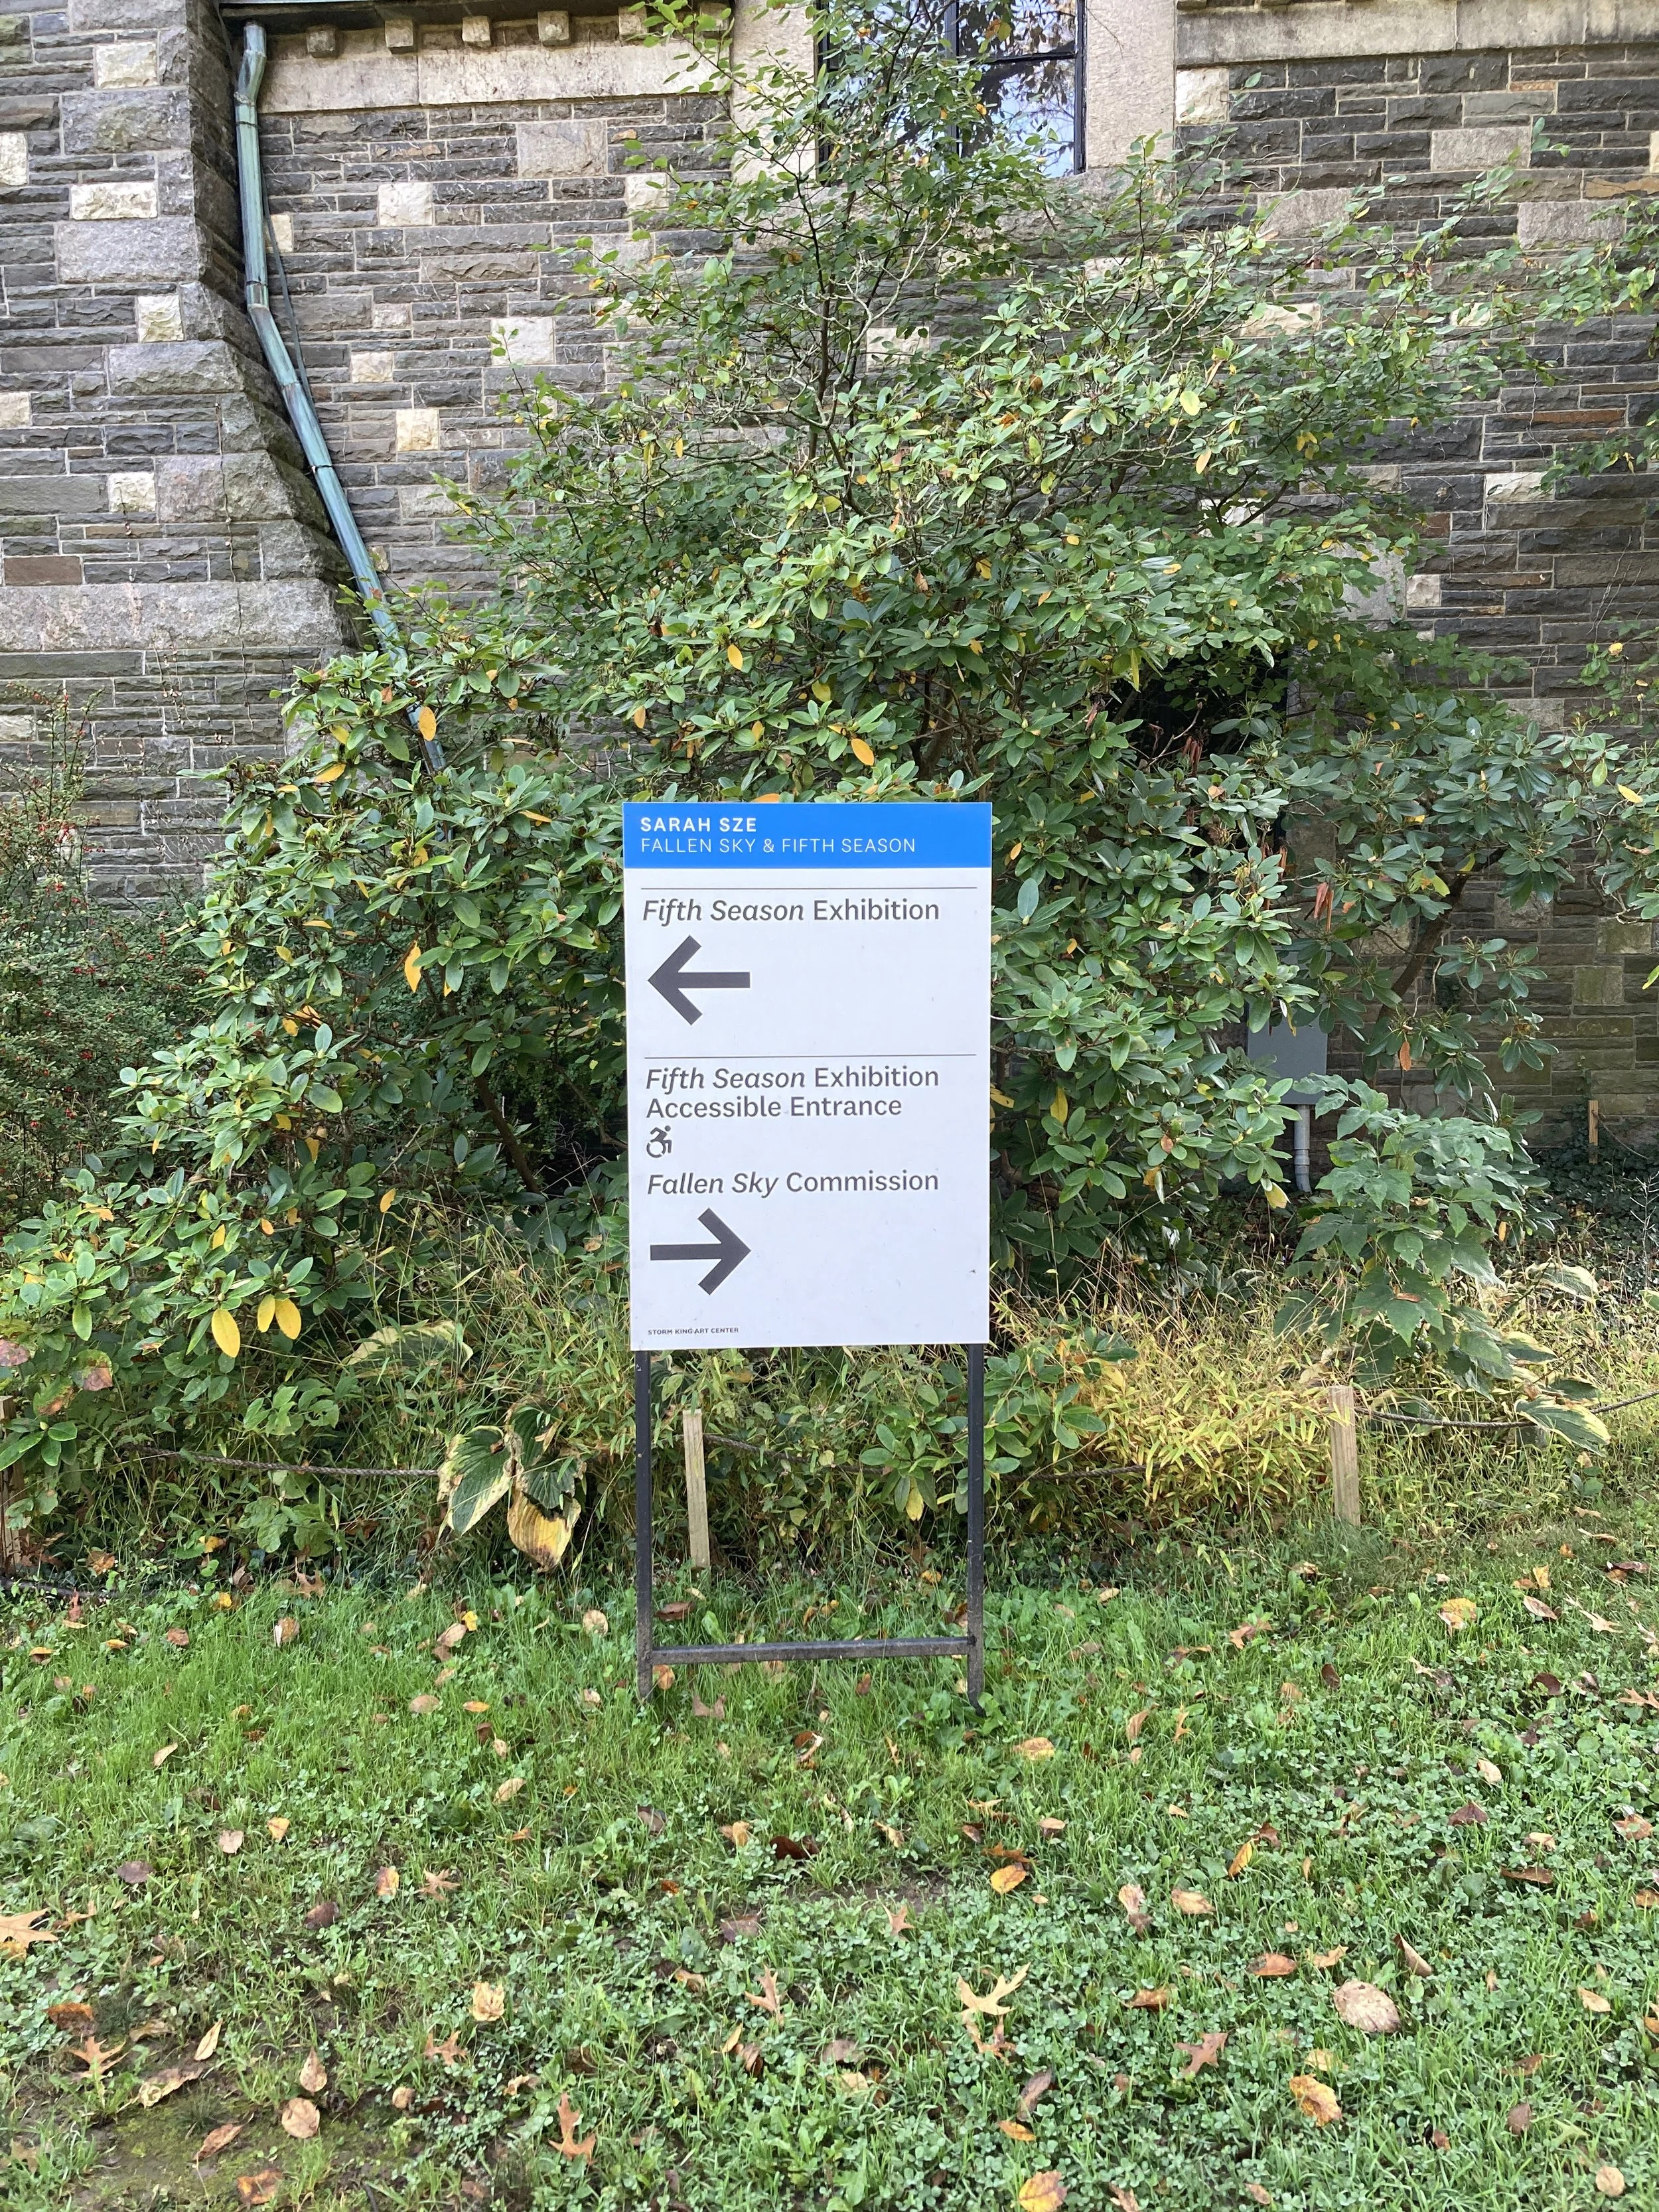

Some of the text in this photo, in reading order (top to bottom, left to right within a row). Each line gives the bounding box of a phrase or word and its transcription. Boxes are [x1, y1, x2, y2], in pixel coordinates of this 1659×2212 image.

[640, 817, 756, 832] SARAH SZE
[642, 838, 914, 852] FALLEN SKY & FIFTH SEASON
[644, 899, 938, 926] Fifth Season Exhibition
[646, 1066, 938, 1094] Fifth Season Exhibition
[646, 1096, 901, 1118] Accessible Entrance
[648, 1170, 938, 1198] Fallen Sky Commission
